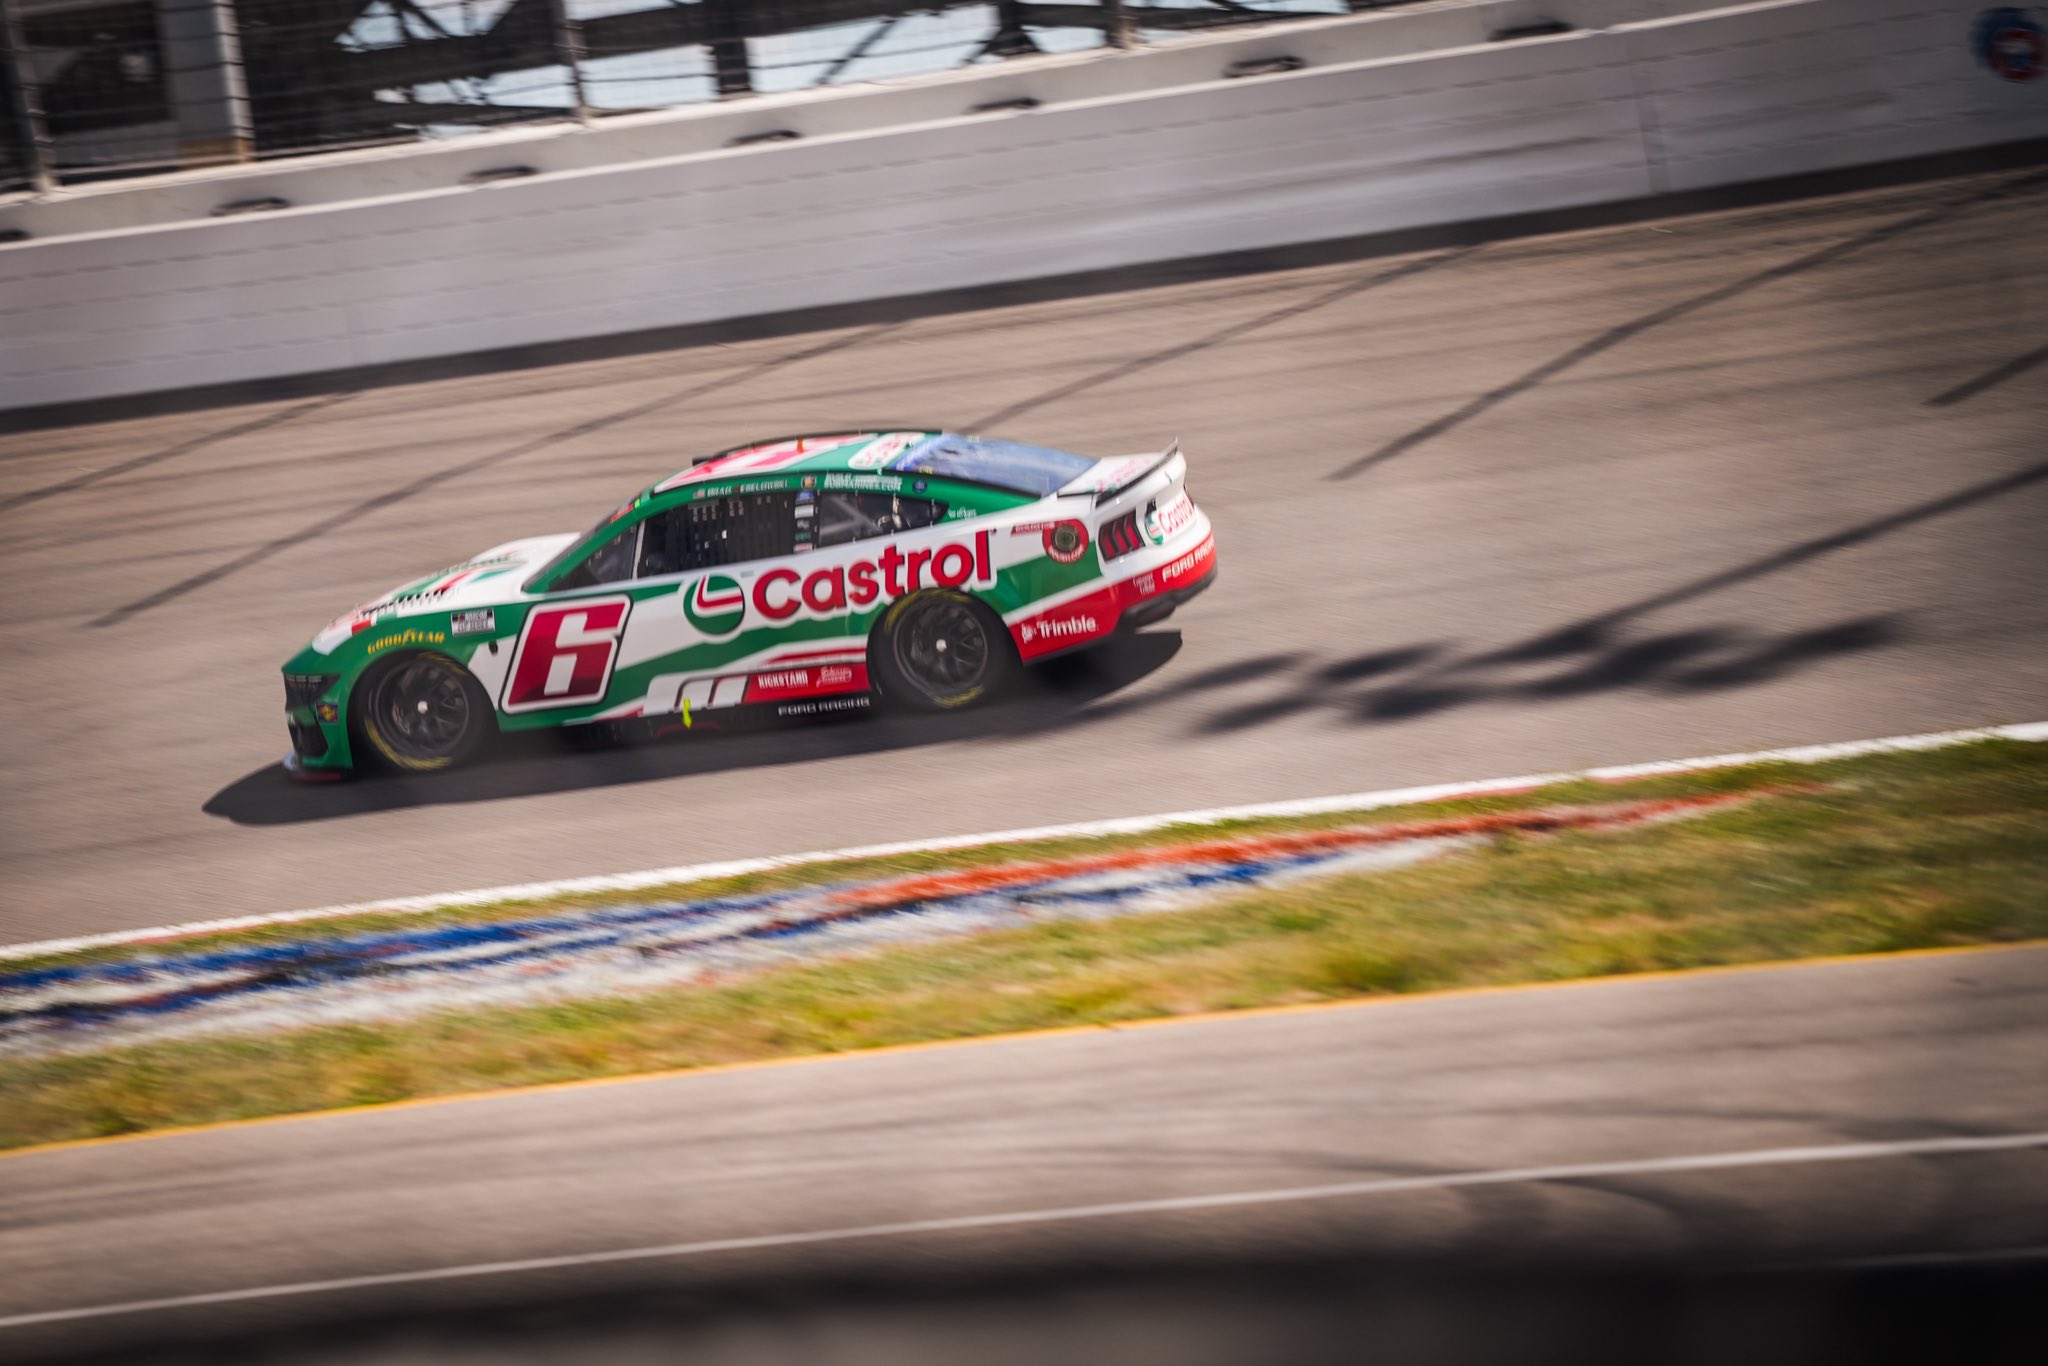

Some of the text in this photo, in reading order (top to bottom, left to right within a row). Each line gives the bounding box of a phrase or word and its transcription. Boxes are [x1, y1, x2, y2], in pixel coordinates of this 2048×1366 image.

[752, 528, 992, 620] Castrol
[1162, 551, 1195, 584] FORD
[1036, 614, 1097, 639] Trimble
[367, 629, 445, 656] GOODYEAR
[504, 598, 628, 709] 6
[758, 669, 809, 689] KICKSTAND
[778, 697, 870, 717] FORD RACING
